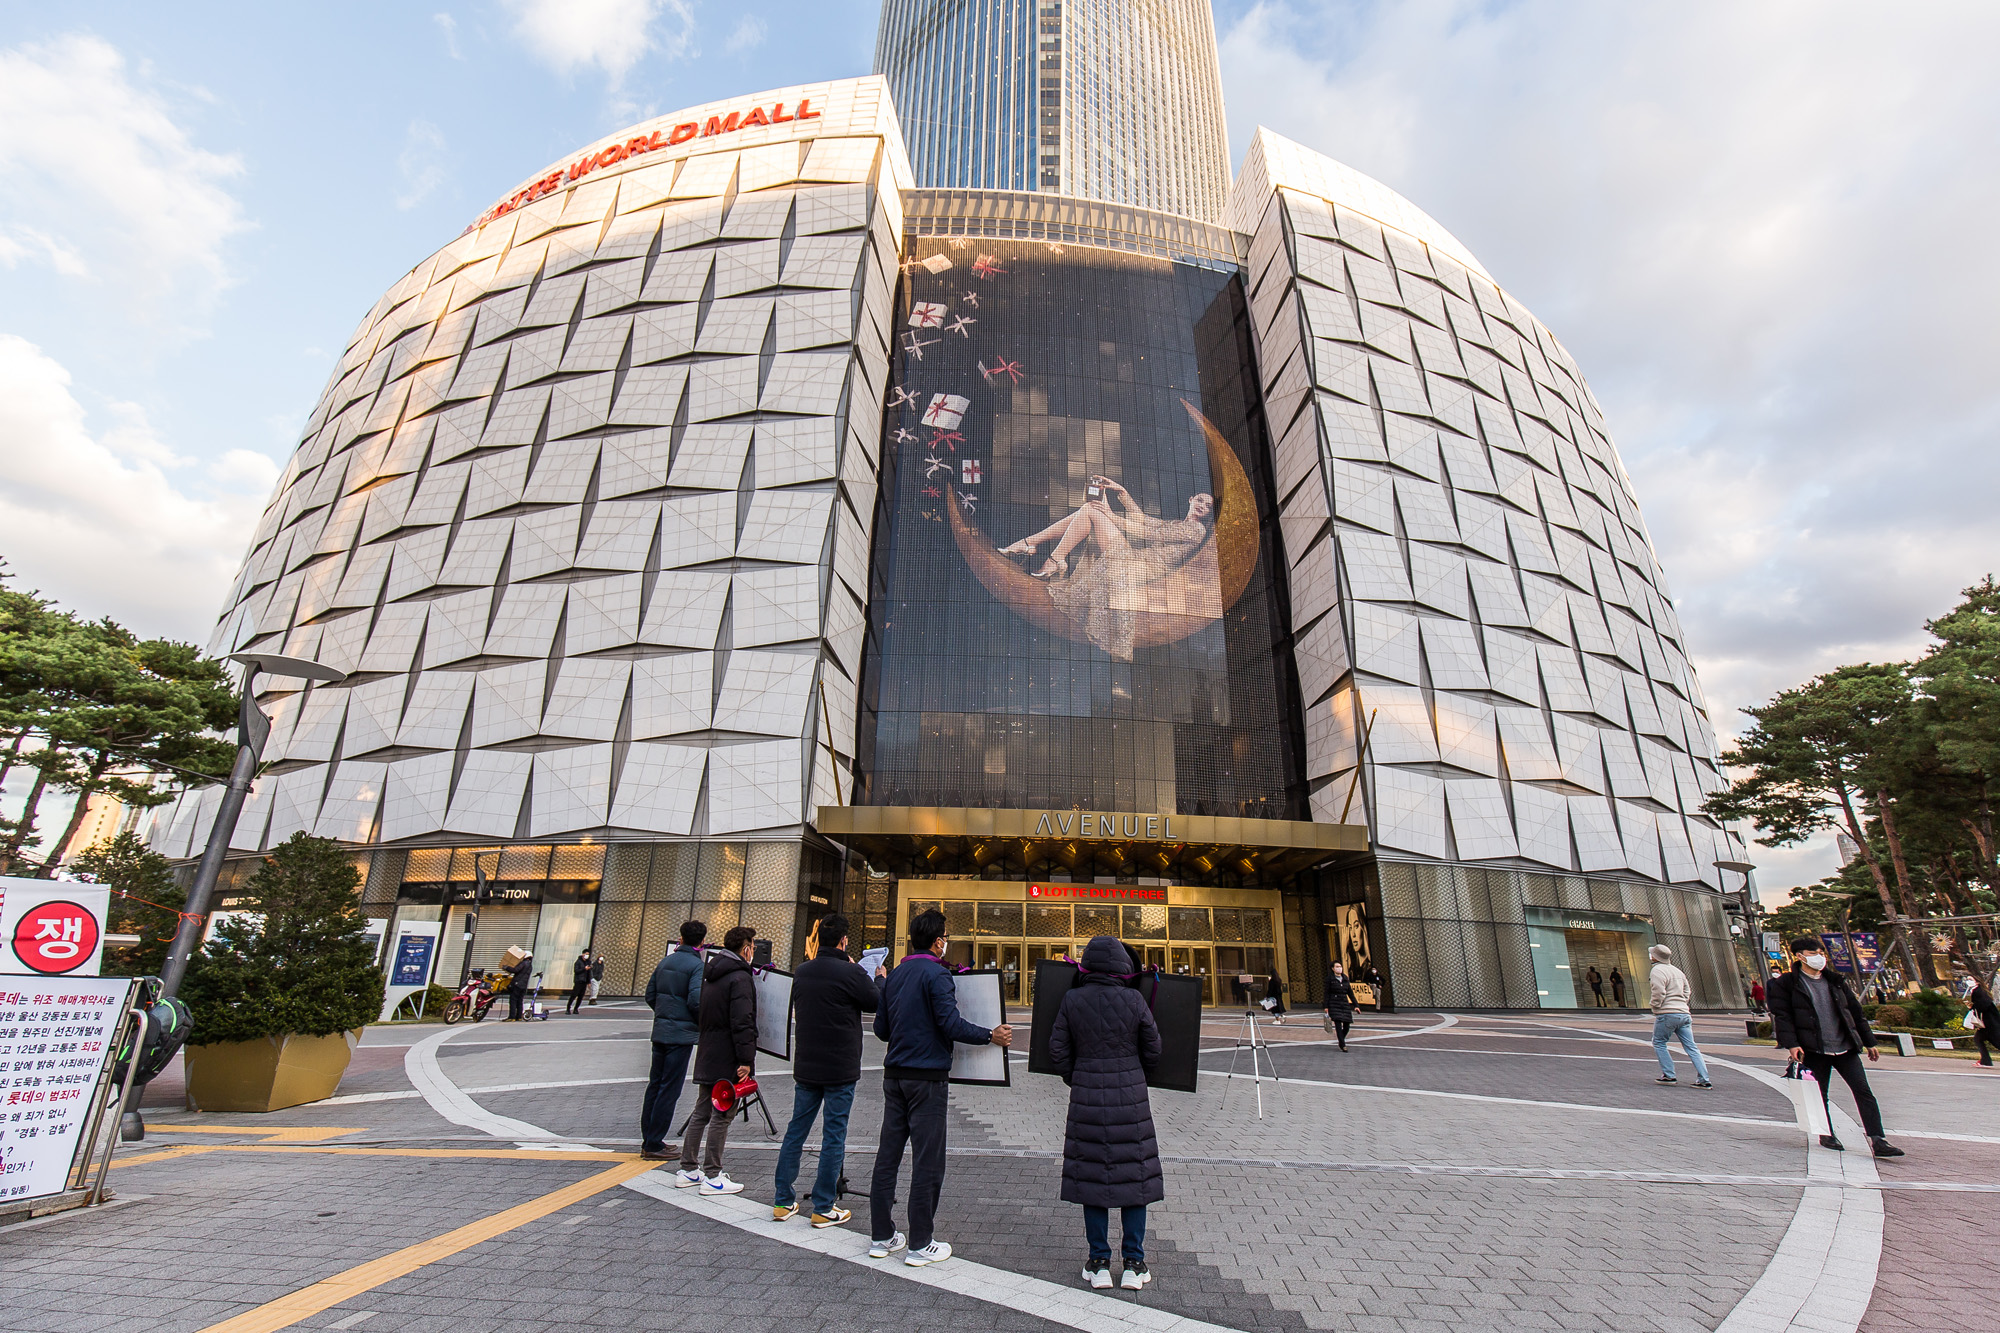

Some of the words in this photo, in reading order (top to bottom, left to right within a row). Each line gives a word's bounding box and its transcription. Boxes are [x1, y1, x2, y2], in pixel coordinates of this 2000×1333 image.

[478, 169, 564, 226] LOTTE
[567, 122, 698, 182] WORLD
[703, 99, 821, 138] MALL
[1035, 813, 1177, 838] AVENUEL
[1044, 886, 1088, 898] LOTTE
[1089, 887, 1128, 899] DUTY
[1130, 889, 1165, 900] FREE
[1569, 919, 1597, 930] CHANEL
[34, 917, 83, 959] 쟁
[1351, 984, 1372, 994] HANEL
[33, 994, 54, 1005] 위조
[57, 995, 115, 1006] 매매계약서로
[18, 1011, 38, 1022] 울산
[41, 1011, 70, 1022] 강동권
[71, 1011, 91, 1021] 토지
[93, 1011, 103, 1021] 및
[22, 1028, 51, 1038] 원주민
[54, 1026, 104, 1037] 선진개발에
[0, 1045, 11, 1055] 고
[16, 1044, 47, 1055] 12년을
[49, 1043, 78, 1054] 고통준
[13, 1061, 34, 1072] 앞에
[37, 1060, 56, 1070] 밝혀
[58, 1057, 100, 1068] 사죄하라!
[12, 1077, 42, 1088] 도둑놈
[46, 1073, 92, 1085] 구속되는데
[7, 1090, 46, 1106] 롯데의
[49, 1089, 81, 1102] 범죄자
[10, 1112, 22, 1123] 왜
[24, 1110, 44, 1121] 죄가
[48, 1108, 67, 1120] 없나
